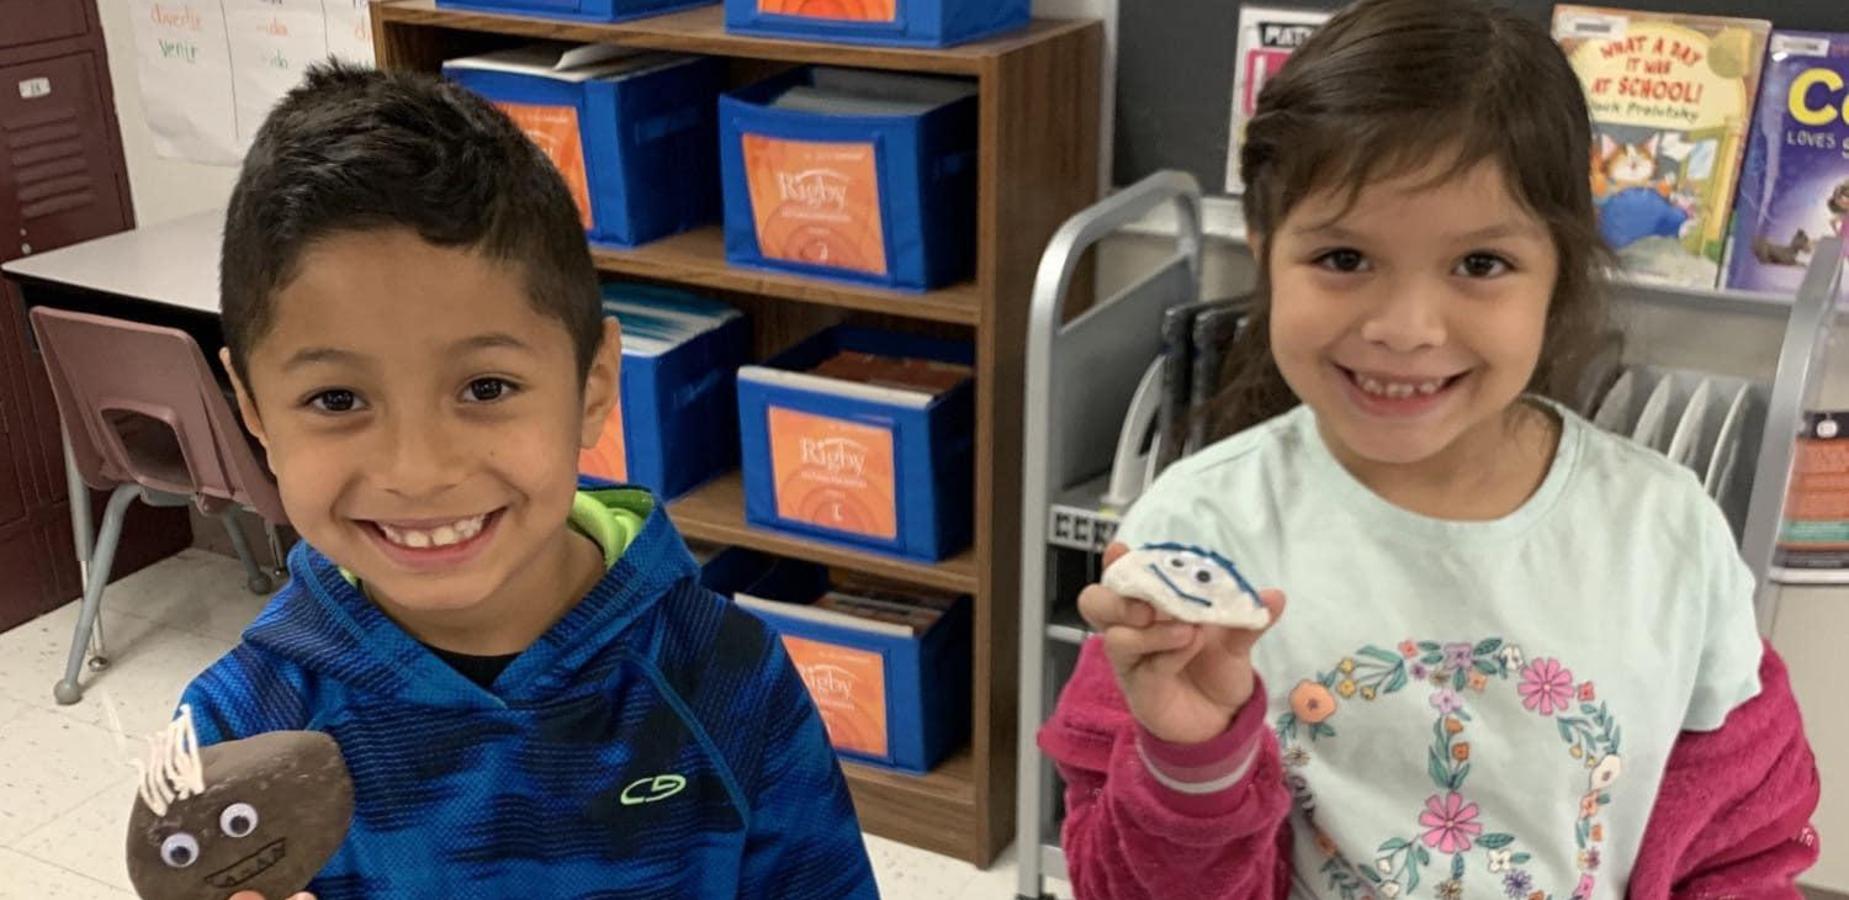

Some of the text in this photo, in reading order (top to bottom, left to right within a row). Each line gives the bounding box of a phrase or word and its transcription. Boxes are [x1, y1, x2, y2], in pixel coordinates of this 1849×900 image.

[1264, 26, 1313, 46] MAT
[1600, 36, 1702, 67] WHAT A DAY
[1626, 58, 1671, 75] IT WAS
[1591, 76, 1704, 104] AT SCHOOL!
[1788, 67, 1849, 126] C
[1787, 130, 1837, 149] LOVES
[777, 169, 850, 210] Rigby
[801, 437, 869, 478] Rigby
